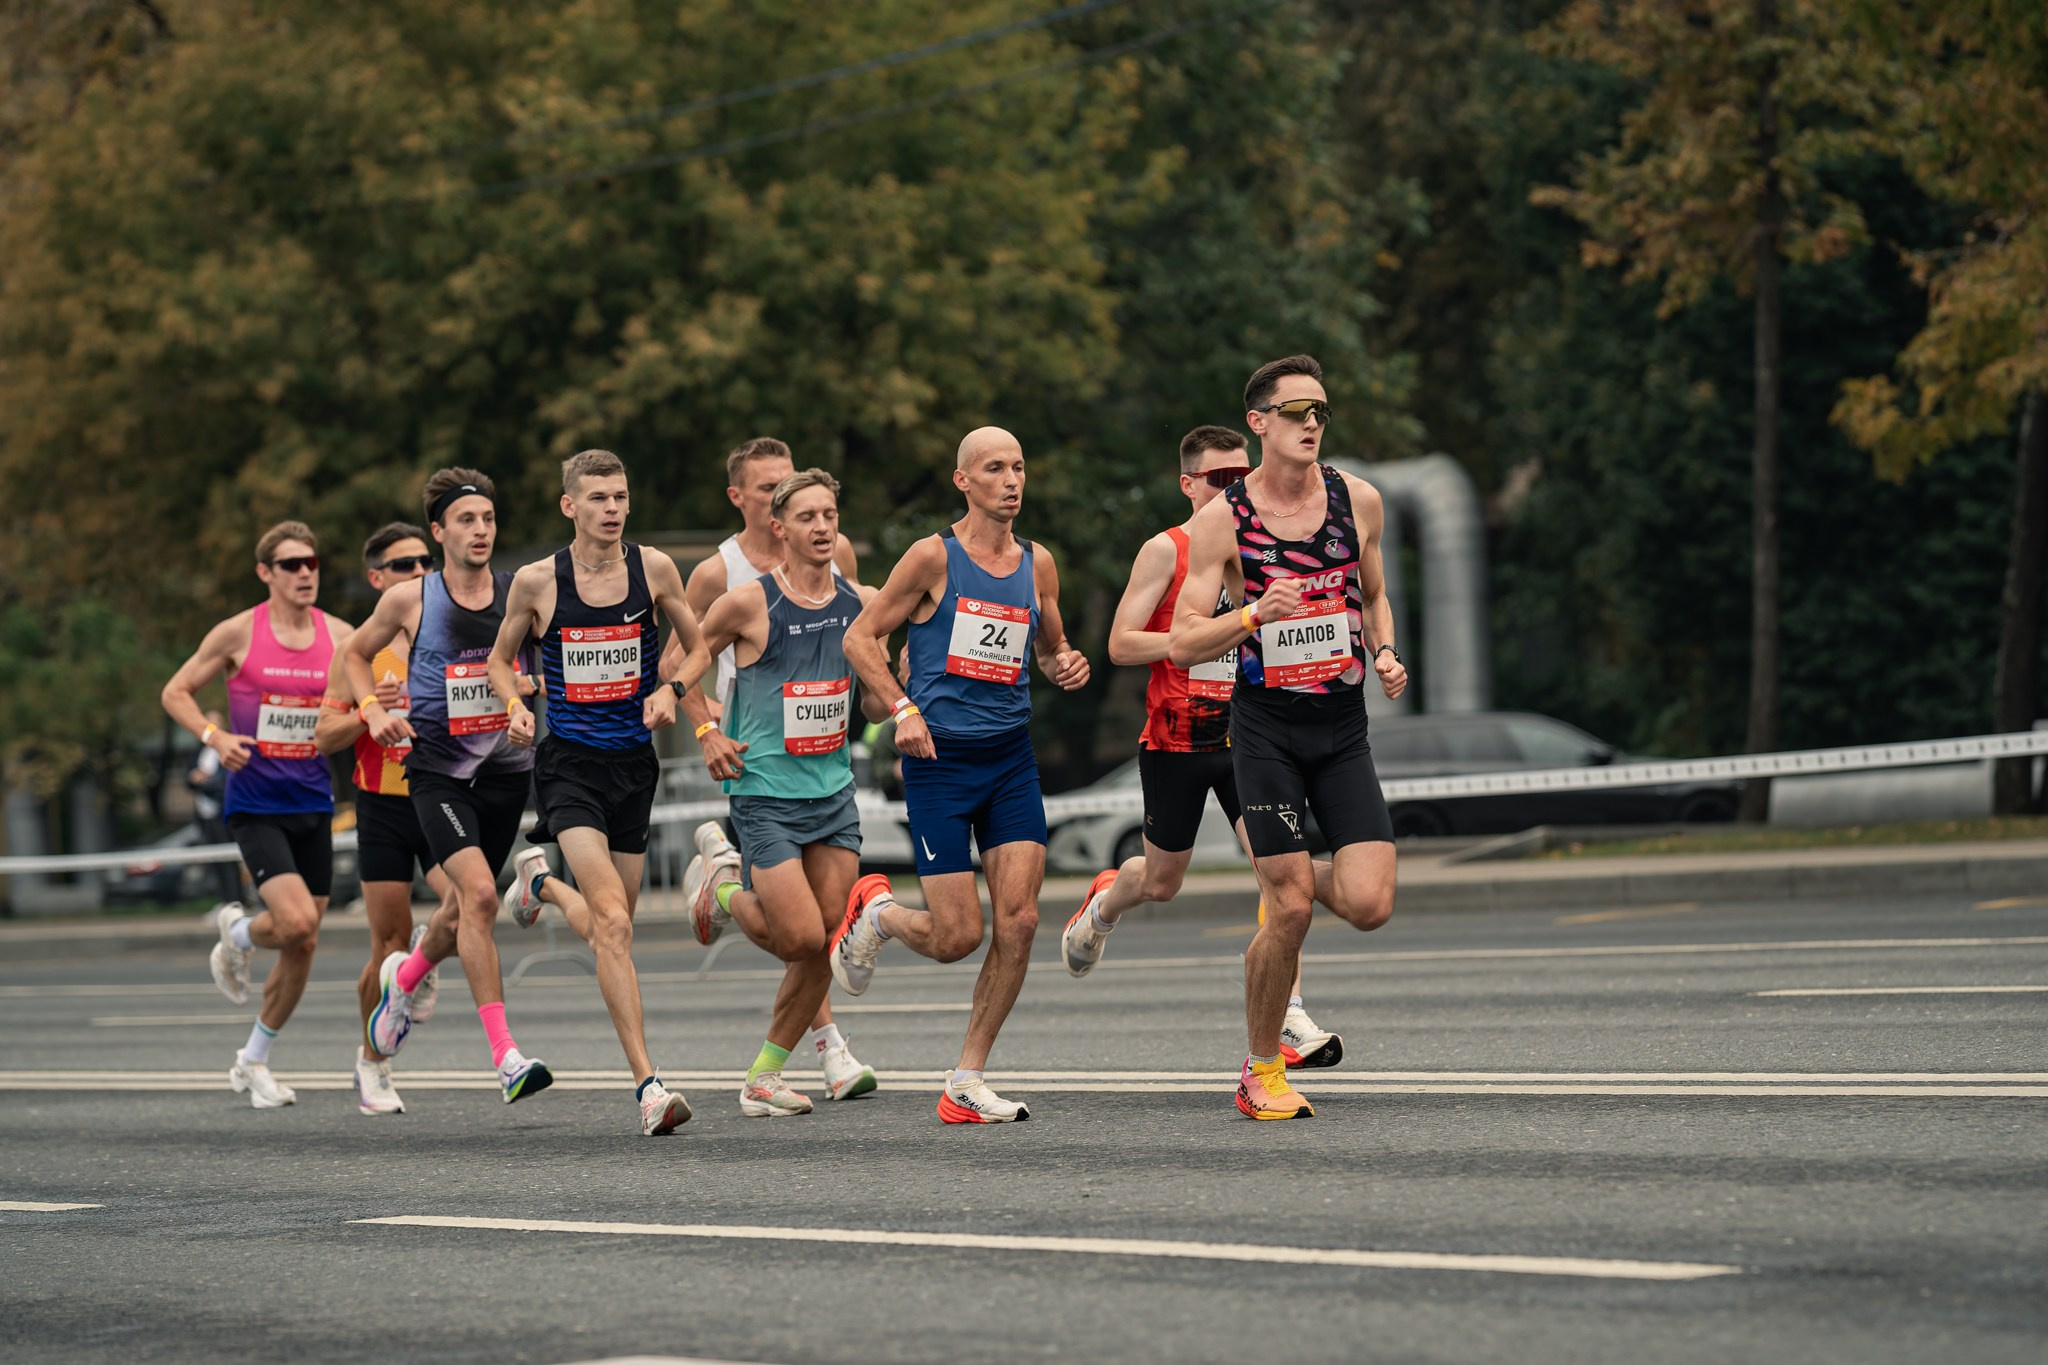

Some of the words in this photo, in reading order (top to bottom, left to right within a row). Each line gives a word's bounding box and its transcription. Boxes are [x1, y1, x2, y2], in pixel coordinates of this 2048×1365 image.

[979, 623, 1009, 649] 24
[1277, 624, 1335, 647] АГАПОВ
[567, 646, 637, 666] КИРГИЗОВ
[968, 648, 1011, 662] ЛУКЬЯНЦЕВ
[452, 683, 498, 701] ЯКУТИ
[796, 700, 845, 721] СУЩЕНЯ
